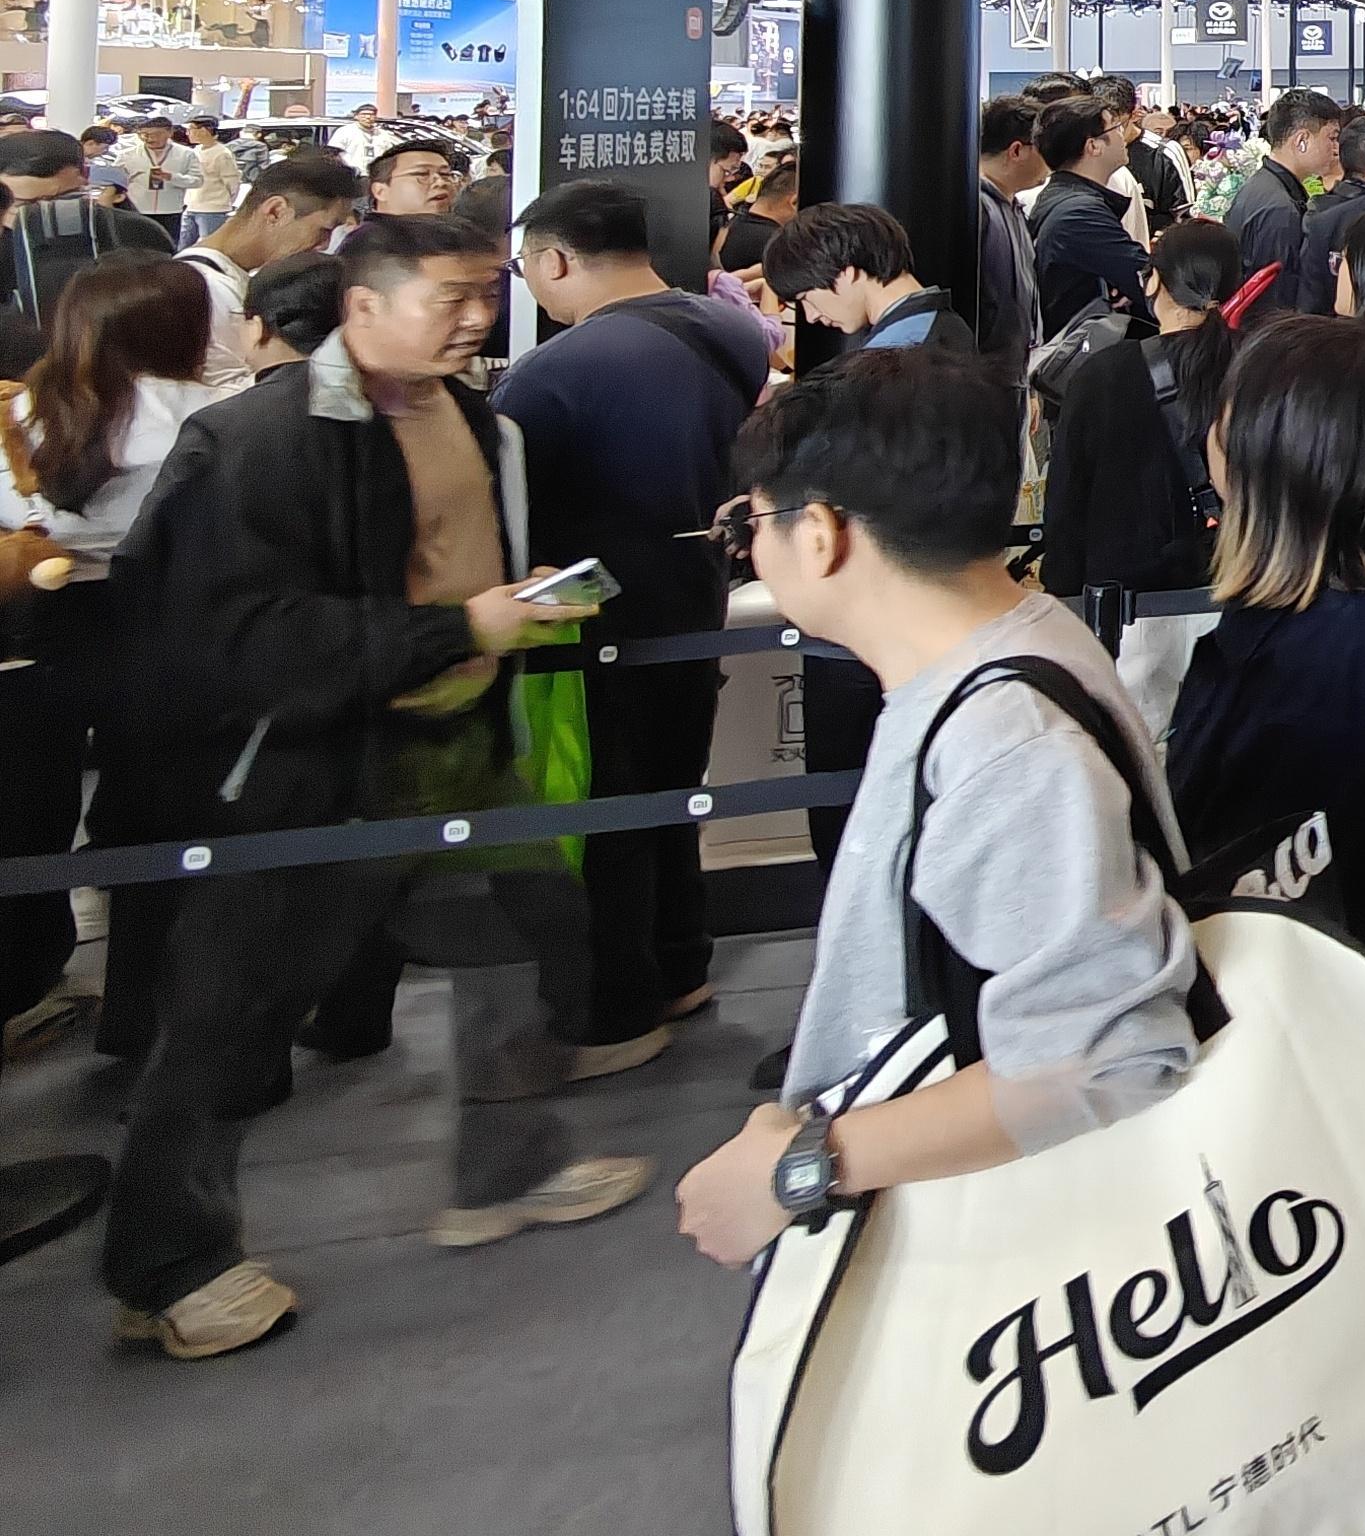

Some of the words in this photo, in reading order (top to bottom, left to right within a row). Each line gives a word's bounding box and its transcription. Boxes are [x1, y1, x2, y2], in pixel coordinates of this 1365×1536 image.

[558, 129, 697, 171] 车展限时免费领取
[965, 1153, 1346, 1475] Hello
